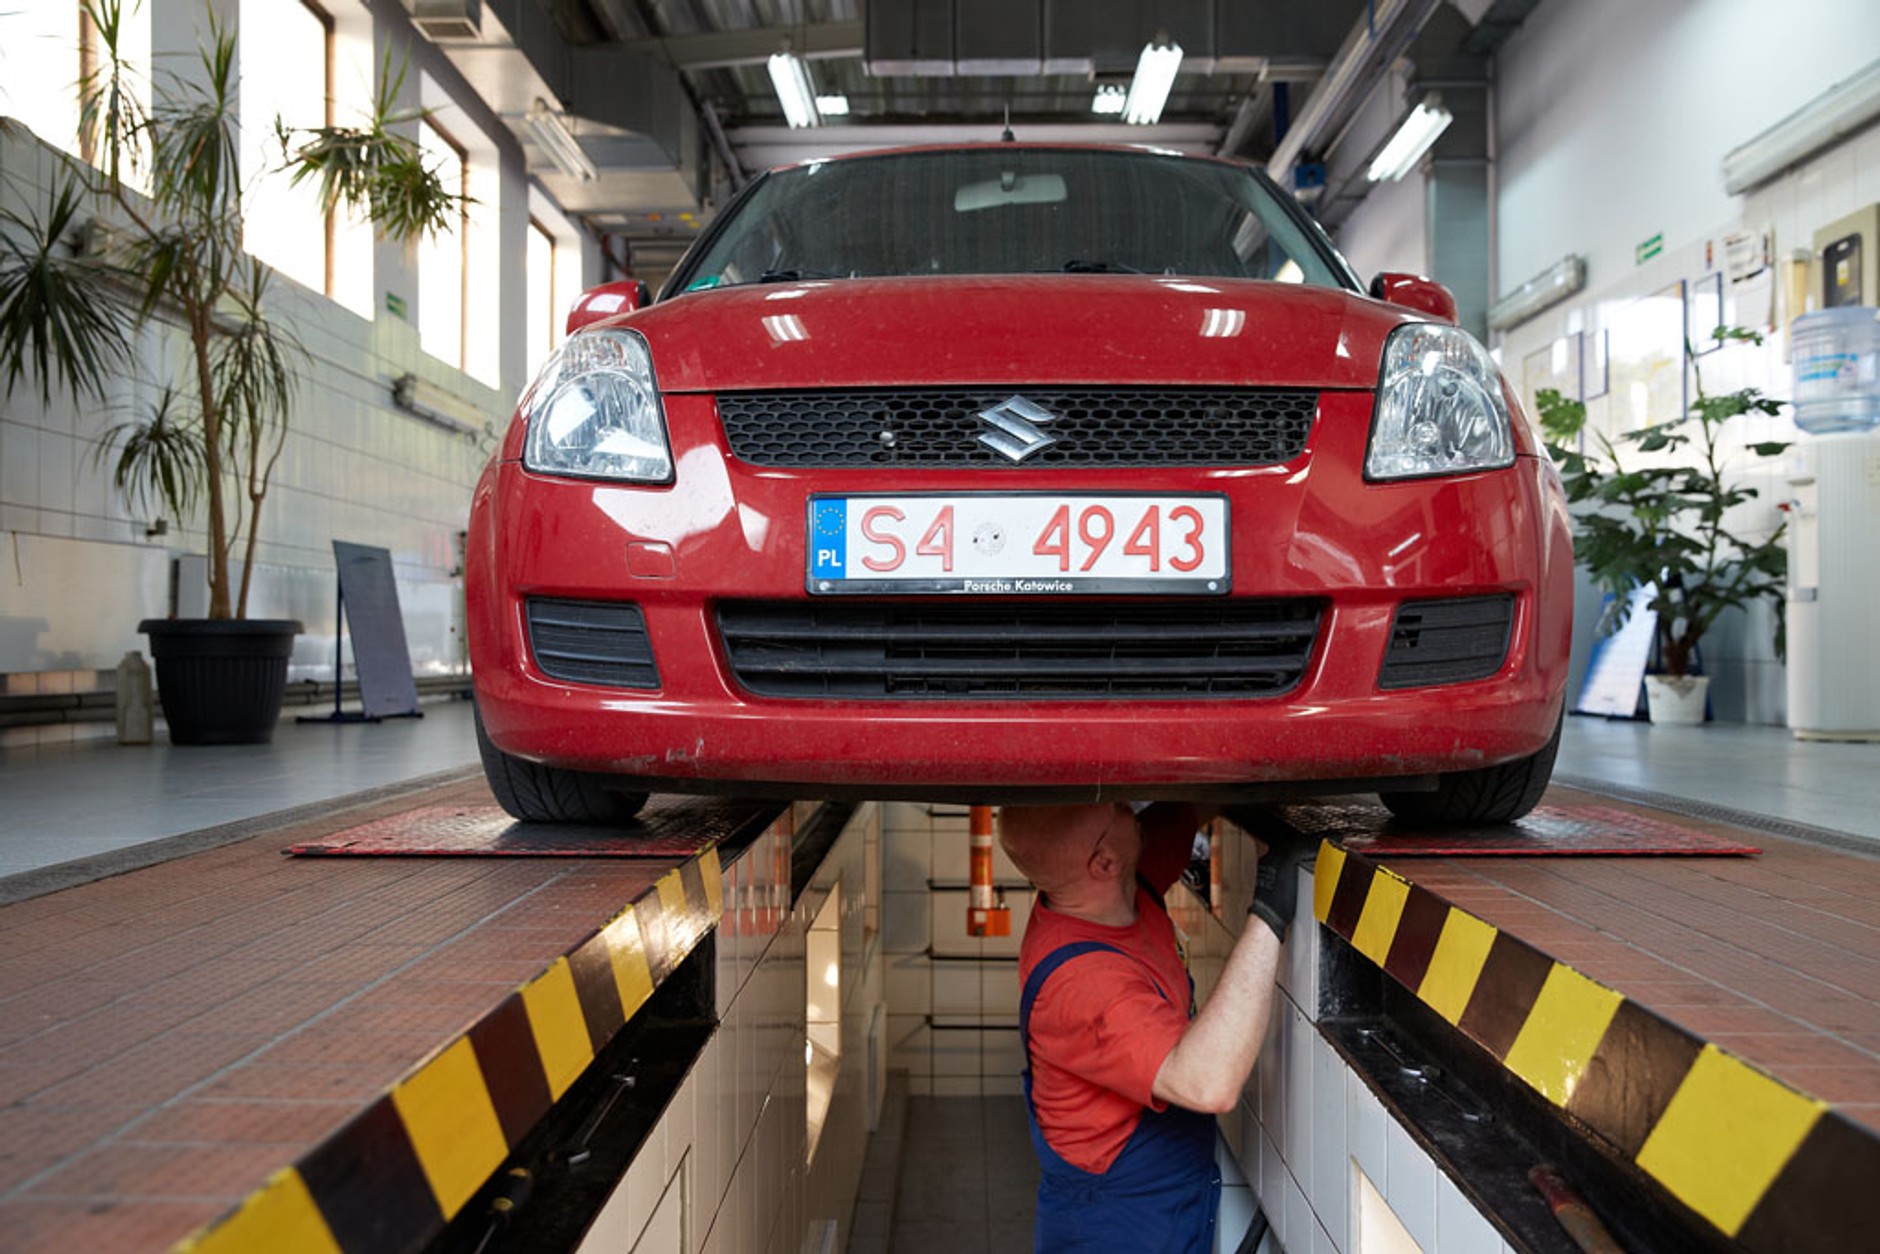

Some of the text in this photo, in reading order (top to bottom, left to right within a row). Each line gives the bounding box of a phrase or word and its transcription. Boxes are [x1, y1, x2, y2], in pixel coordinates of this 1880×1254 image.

[861, 505, 1204, 572] S4 4943
[818, 550, 841, 567] PL
[963, 580, 1074, 592] Porsche Katowice
